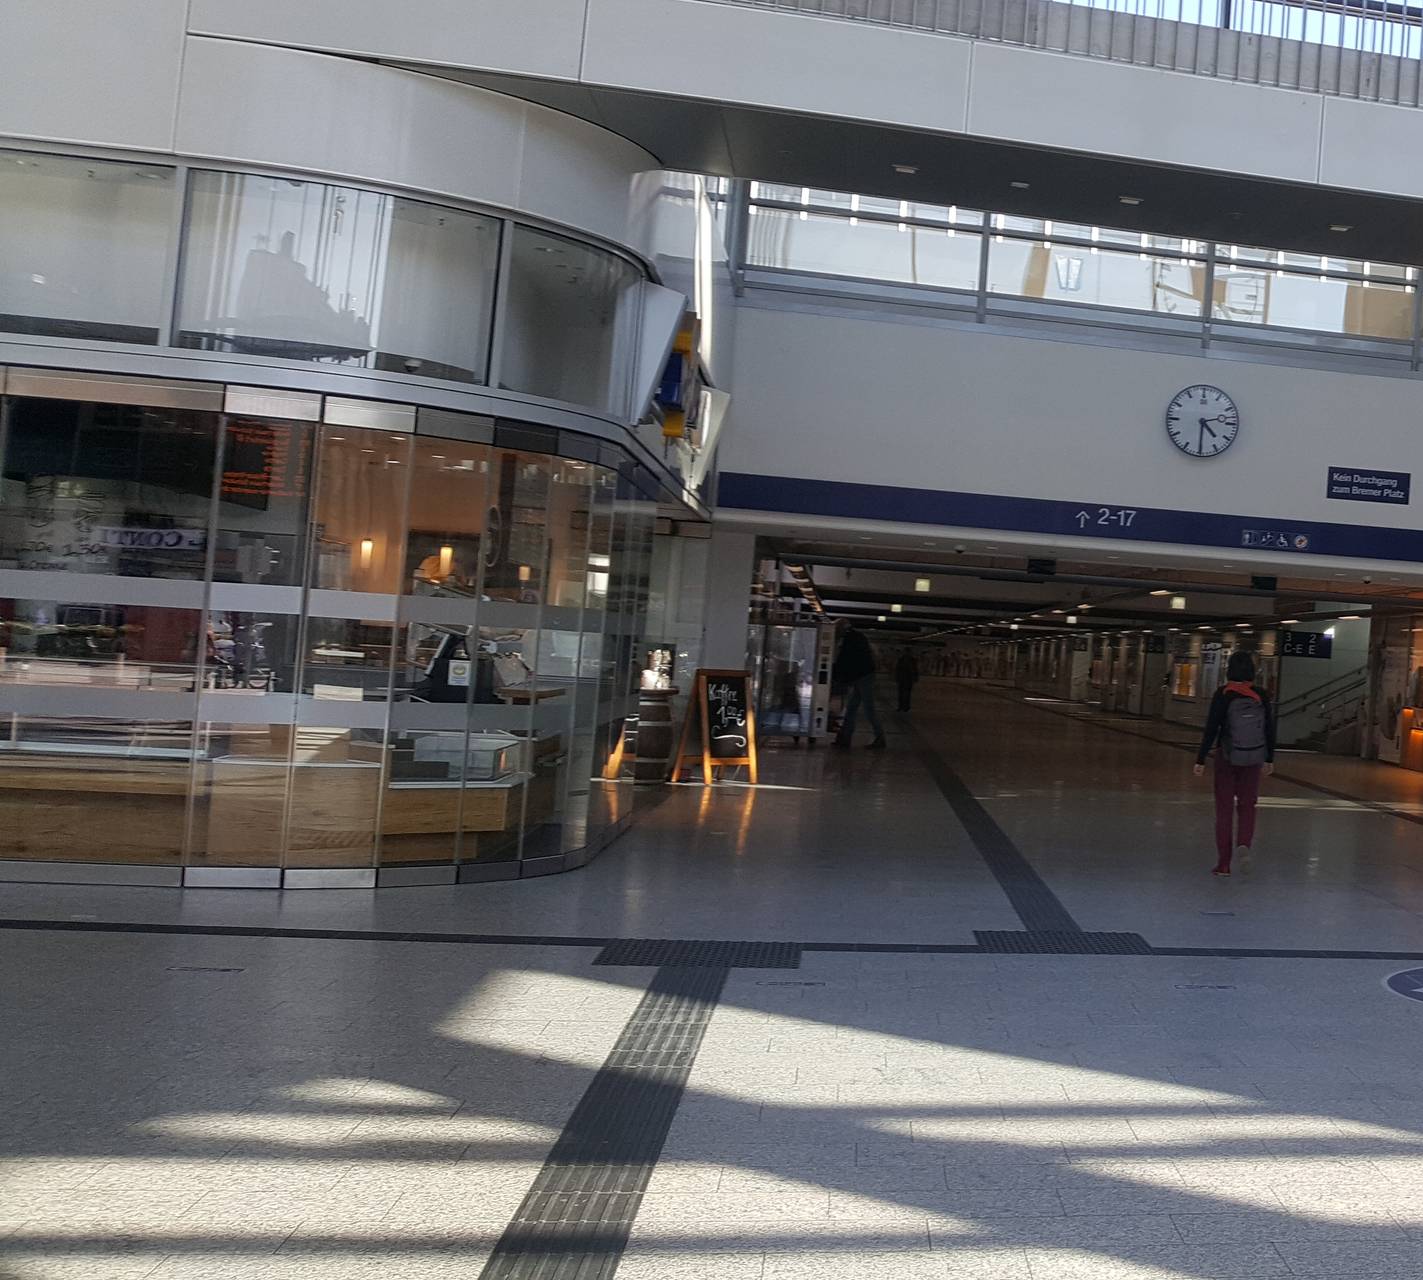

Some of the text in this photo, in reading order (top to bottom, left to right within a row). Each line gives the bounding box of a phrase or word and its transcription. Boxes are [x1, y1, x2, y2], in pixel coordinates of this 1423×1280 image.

[1333, 472, 1398, 488] Kein Durchgang
[1352, 486, 1381, 496] Bremer
[1383, 488, 1405, 498] Platz
[1097, 508, 1137, 527] 2-17
[1309, 634, 1317, 643] 2
[1308, 645, 1316, 655] E
